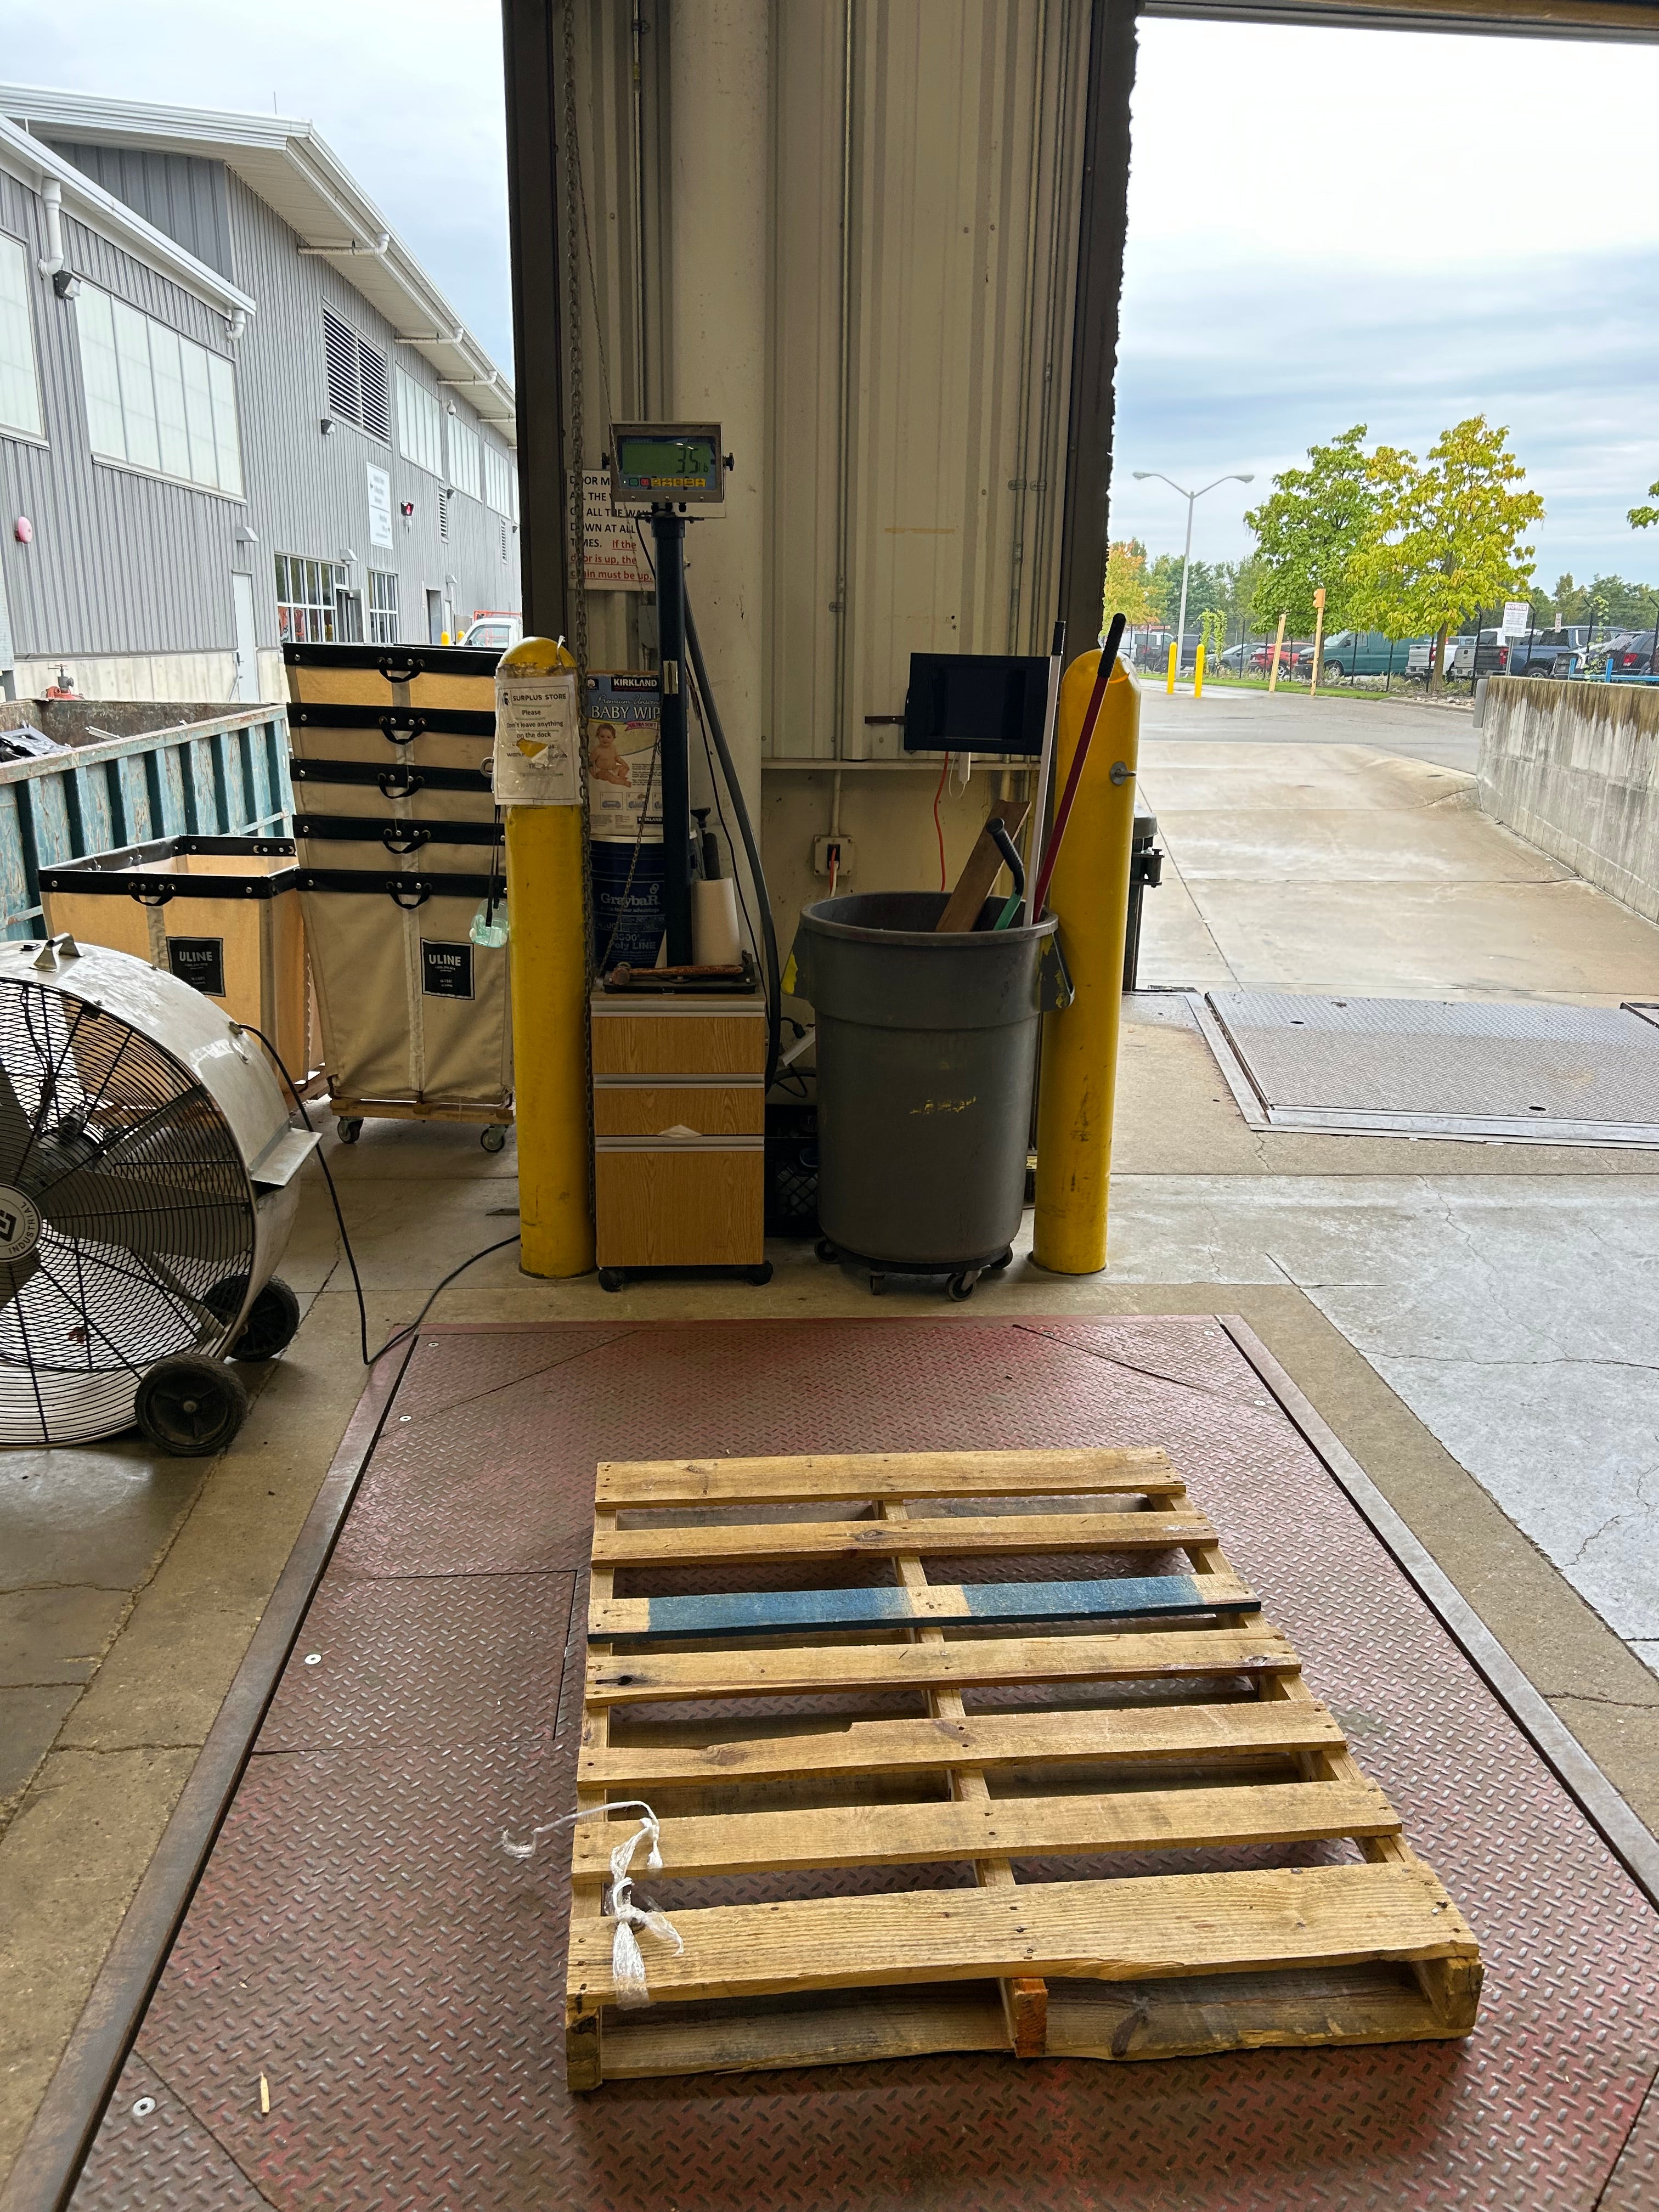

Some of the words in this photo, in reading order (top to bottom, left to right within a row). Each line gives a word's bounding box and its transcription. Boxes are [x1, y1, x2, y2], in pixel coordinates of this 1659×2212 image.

[675, 448, 698, 473] 35
[570, 476, 598, 485] DOR
[588, 492, 606, 501] THE
[586, 507, 602, 517] ALL
[570, 522, 602, 532] DWN
[605, 524, 617, 533] AT
[619, 524, 636, 533] ALL
[570, 538, 602, 548] TMES.
[612, 539, 619, 549] If
[622, 540, 636, 549] the
[571, 554, 592, 563] dor
[595, 554, 602, 563] is
[605, 556, 619, 565] up,
[622, 555, 637, 565] the
[598, 571, 621, 579] must
[624, 571, 635, 579] be
[613, 678, 658, 687] KIRKLAND
[597, 694, 631, 705] Premium
[632, 695, 661, 706] Unscen
[591, 706, 630, 719] BABY
[634, 707, 661, 720] WIP
[632, 941, 656, 950] LINE
[179, 951, 213, 962] ULINE
[428, 954, 461, 966] ULINE
[8, 1201, 36, 1255] INDUSTRIAL
